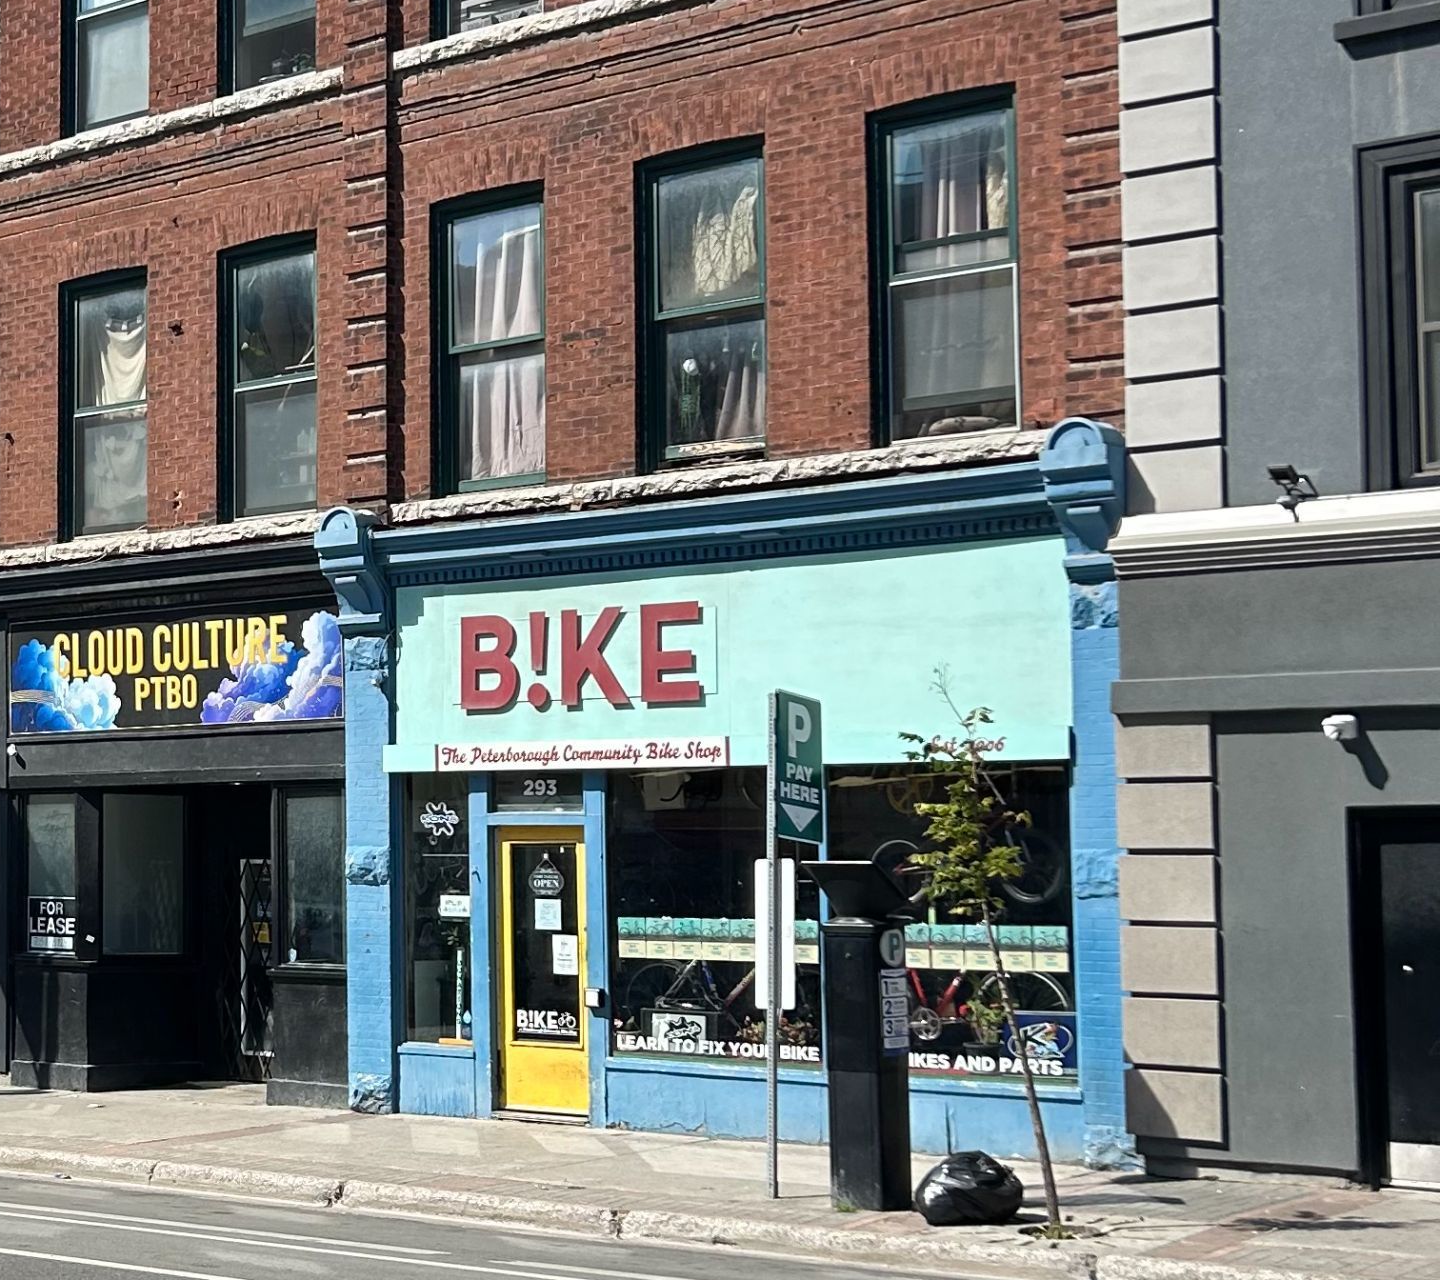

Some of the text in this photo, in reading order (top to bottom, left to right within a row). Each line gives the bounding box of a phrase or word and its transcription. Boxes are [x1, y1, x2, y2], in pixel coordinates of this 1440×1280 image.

[53, 614, 289, 678] CLOUD CULTURE
[461, 600, 701, 710] B!KE
[134, 674, 198, 712] PTBO
[787, 701, 812, 759] P
[441, 741, 722, 766] The Peterborough Community Bike Shop
[785, 762, 813, 783] PAY
[523, 779, 558, 796] 293
[779, 781, 820, 805] HERE
[533, 878, 560, 889] OPEN
[40, 901, 64, 915] FOR
[29, 916, 76, 935] LEASE
[888, 932, 900, 961] P
[882, 980, 890, 996] 1
[884, 999, 893, 1015] 2
[516, 1008, 559, 1030] B!KE
[885, 1019, 894, 1035] 3
[616, 1034, 821, 1062] LEARN TO FIX YOU BIKE
[953, 1054, 996, 1072] AND
[999, 1057, 1064, 1076] PARTS
